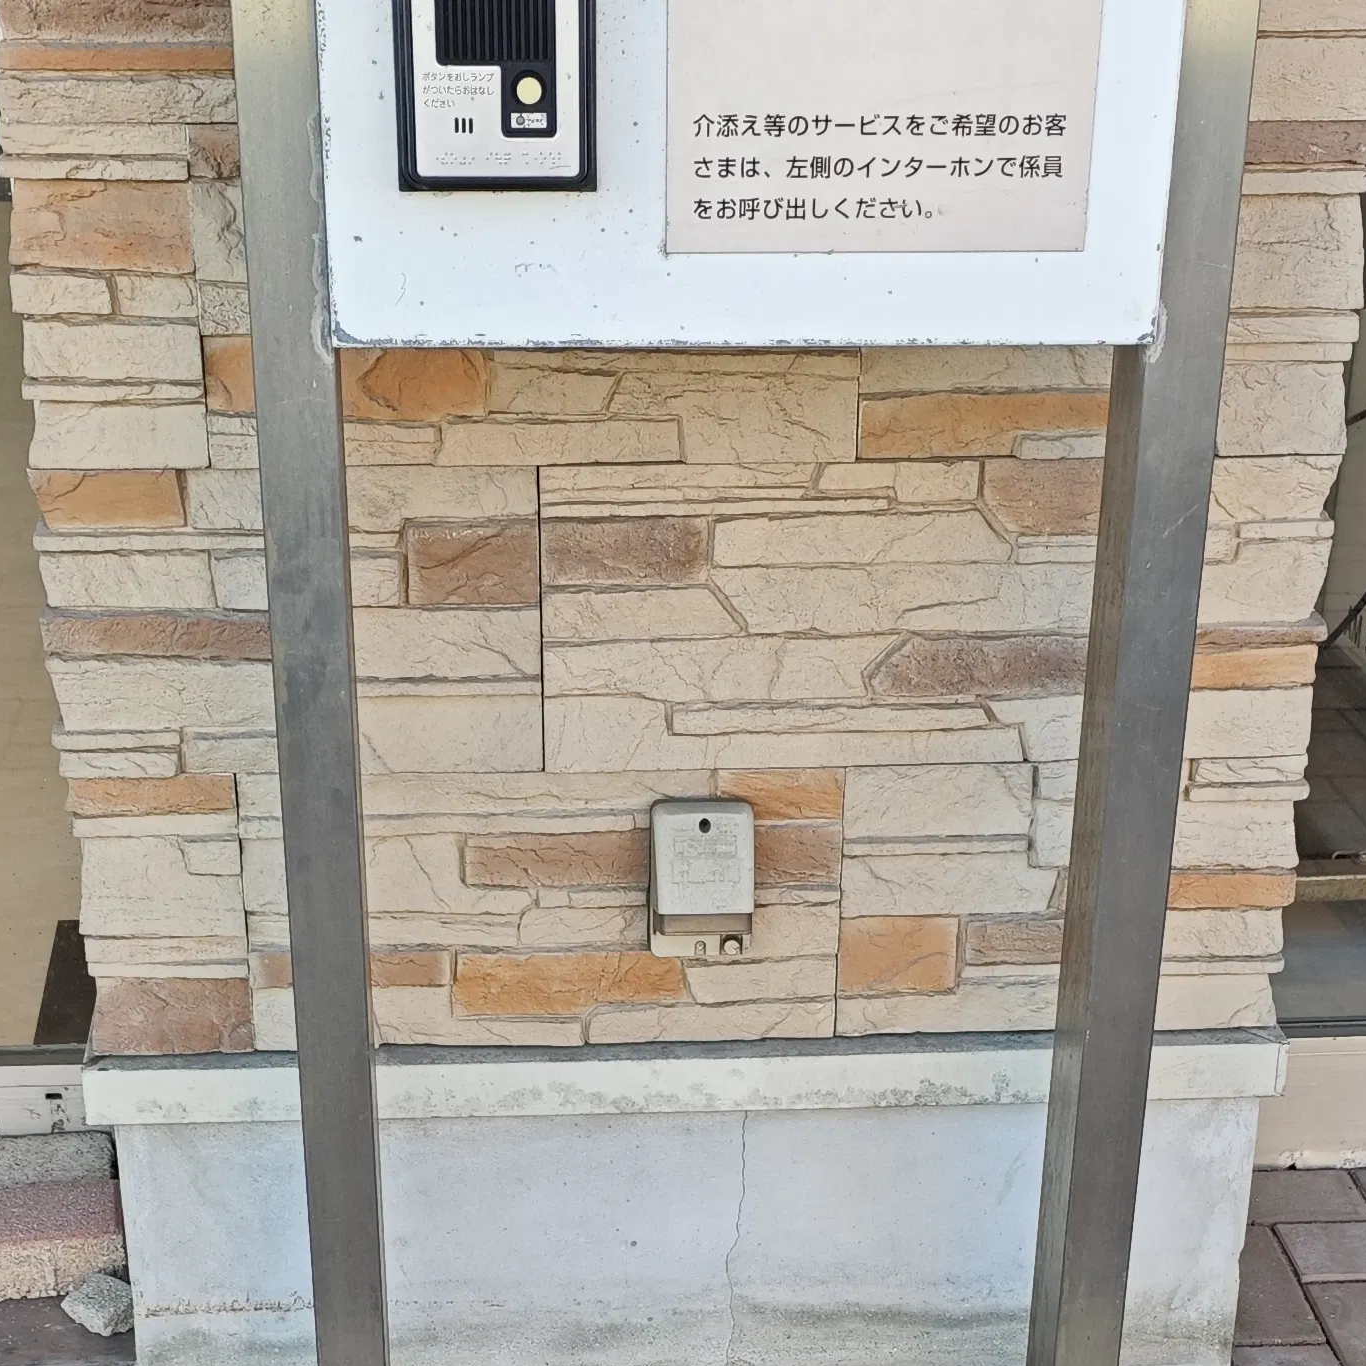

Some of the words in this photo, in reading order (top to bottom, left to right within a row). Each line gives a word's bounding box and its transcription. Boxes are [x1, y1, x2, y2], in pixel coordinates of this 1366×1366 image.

[422, 72, 495, 83] ボタンをおしランプ
[422, 85, 495, 96] がついたらおはなし
[423, 98, 456, 109] ください
[693, 113, 1067, 138] 介添え等のサービスをご希望のお客
[693, 155, 1063, 179] さまは、左側のインターホンで係員
[693, 197, 933, 221] をお呼び出しください。
